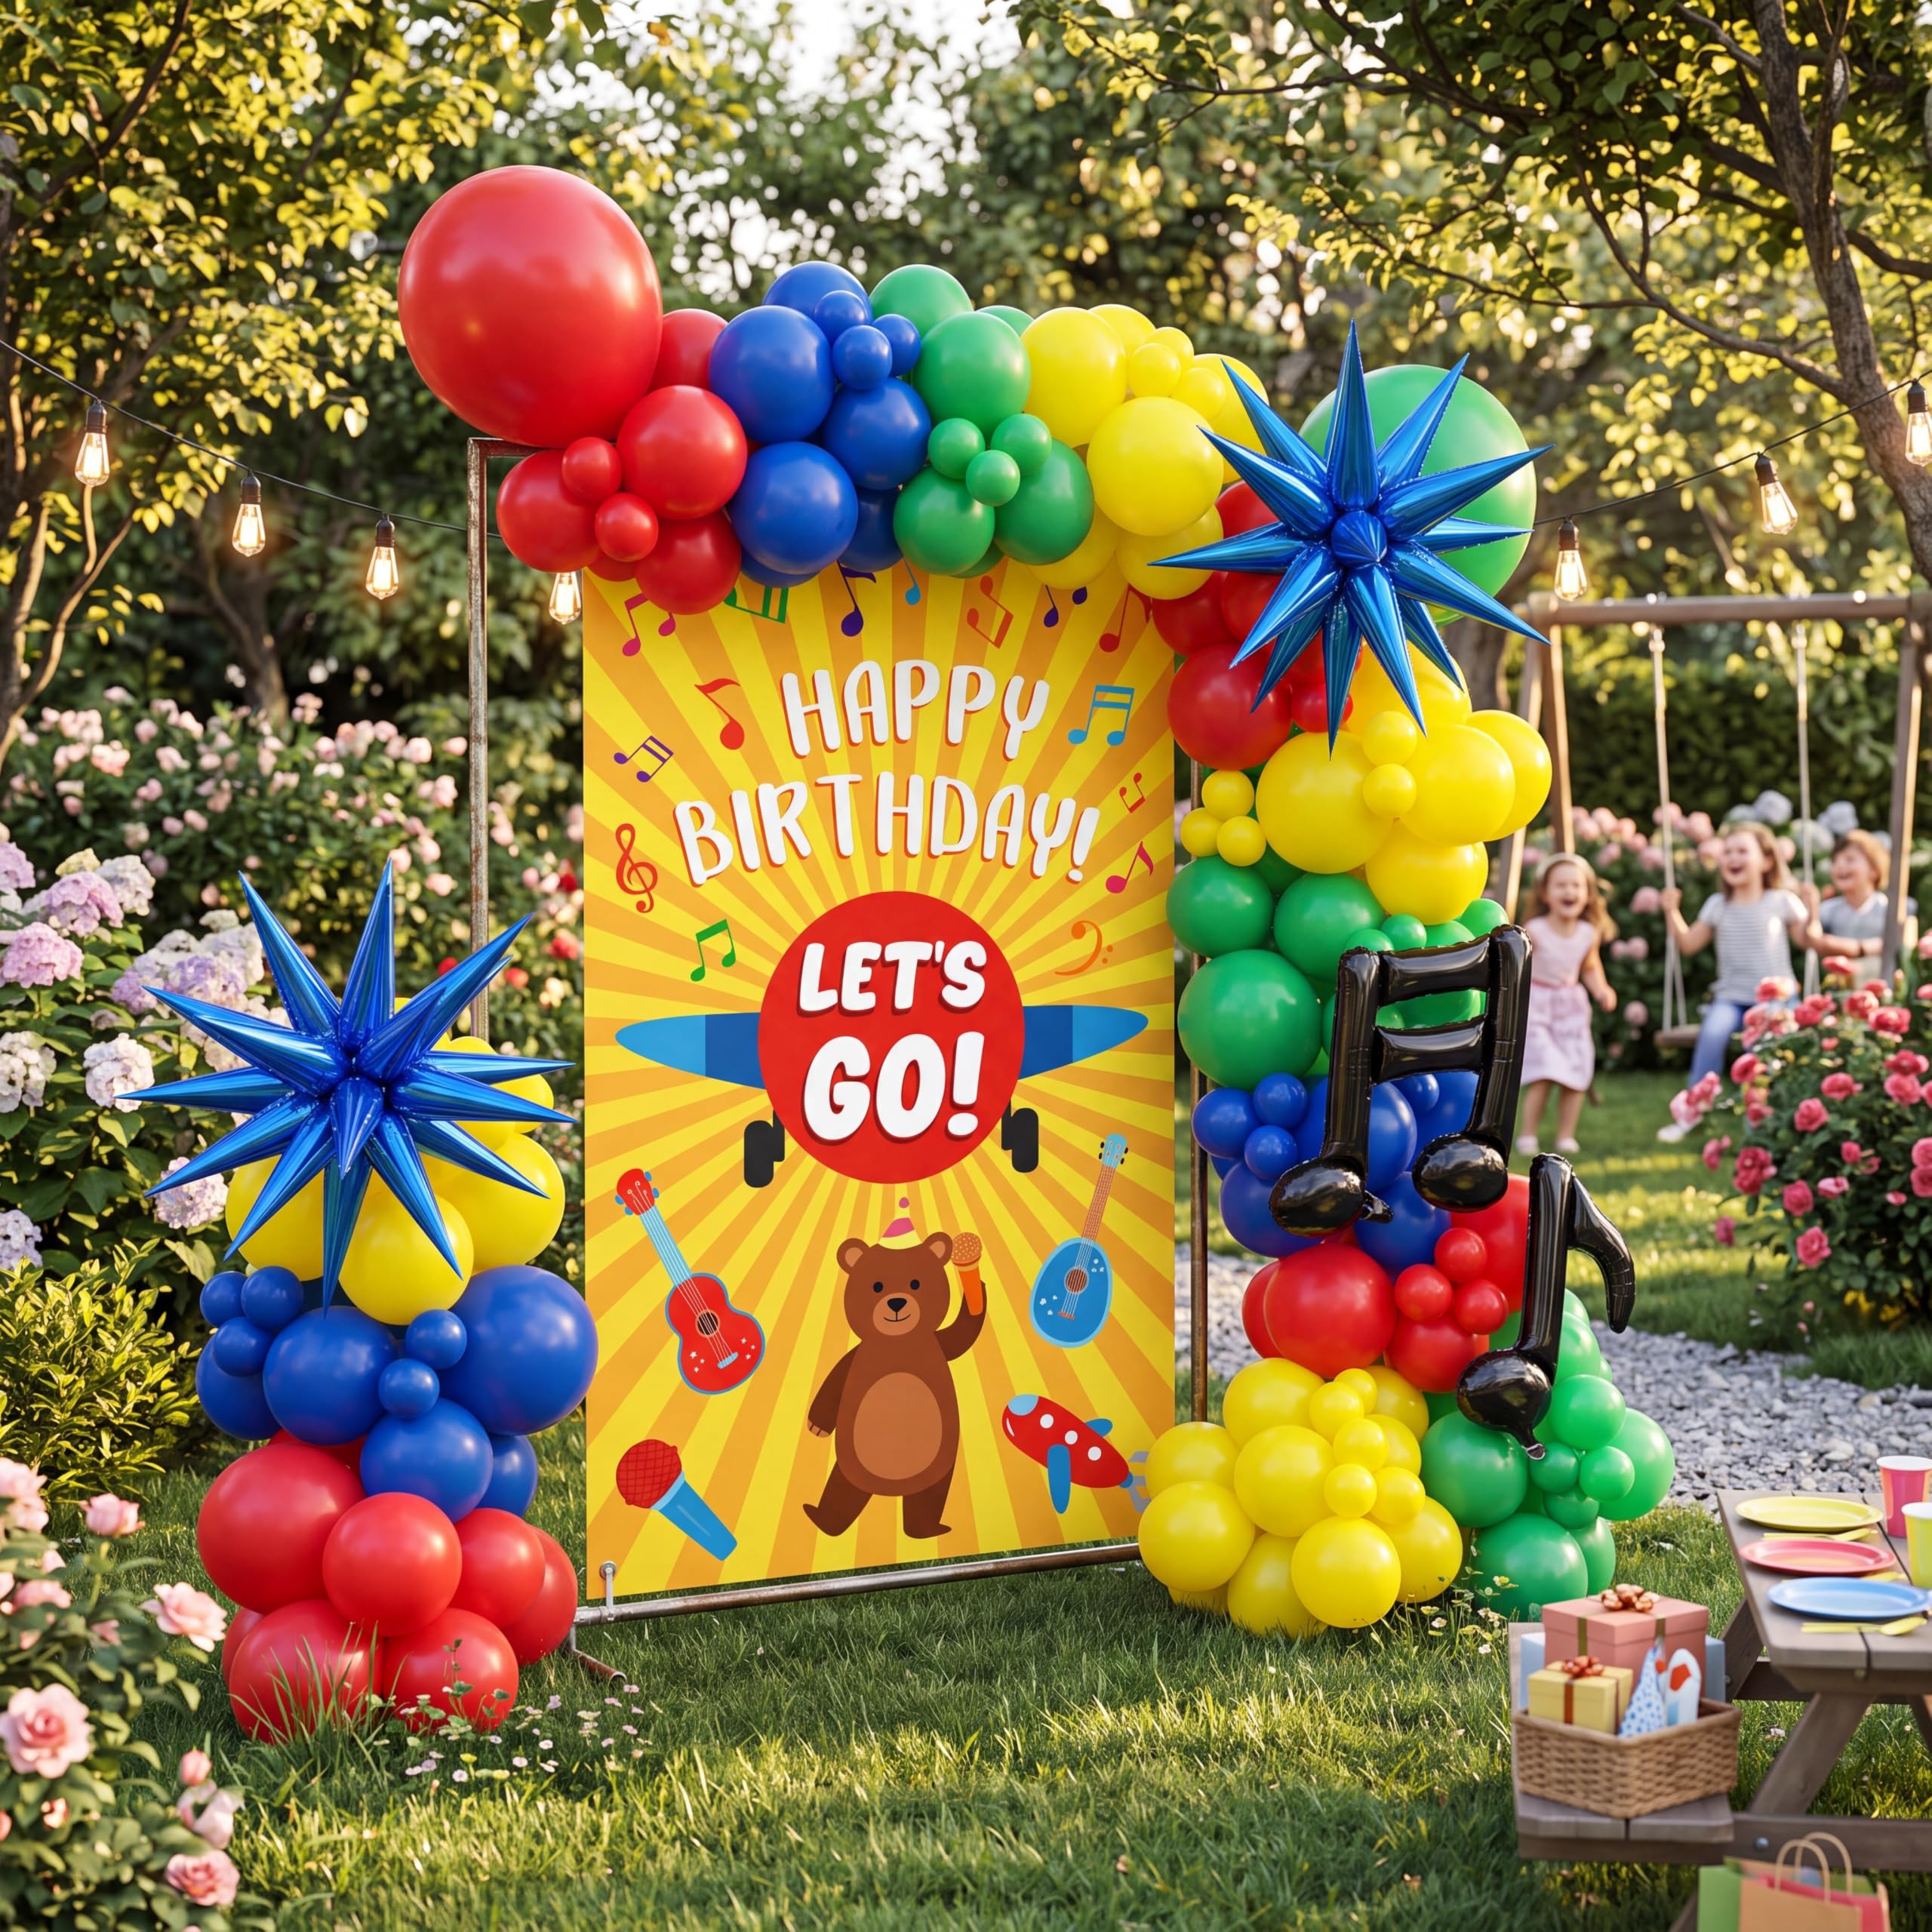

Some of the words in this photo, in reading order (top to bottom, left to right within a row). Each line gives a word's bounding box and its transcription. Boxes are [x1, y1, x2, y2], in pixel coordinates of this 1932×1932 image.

[780, 660, 1050, 761] HAPPY
[674, 771, 1100, 886] BIRTHDAY!
[797, 940, 987, 1017] LET'S
[801, 1031, 985, 1146] GO!
